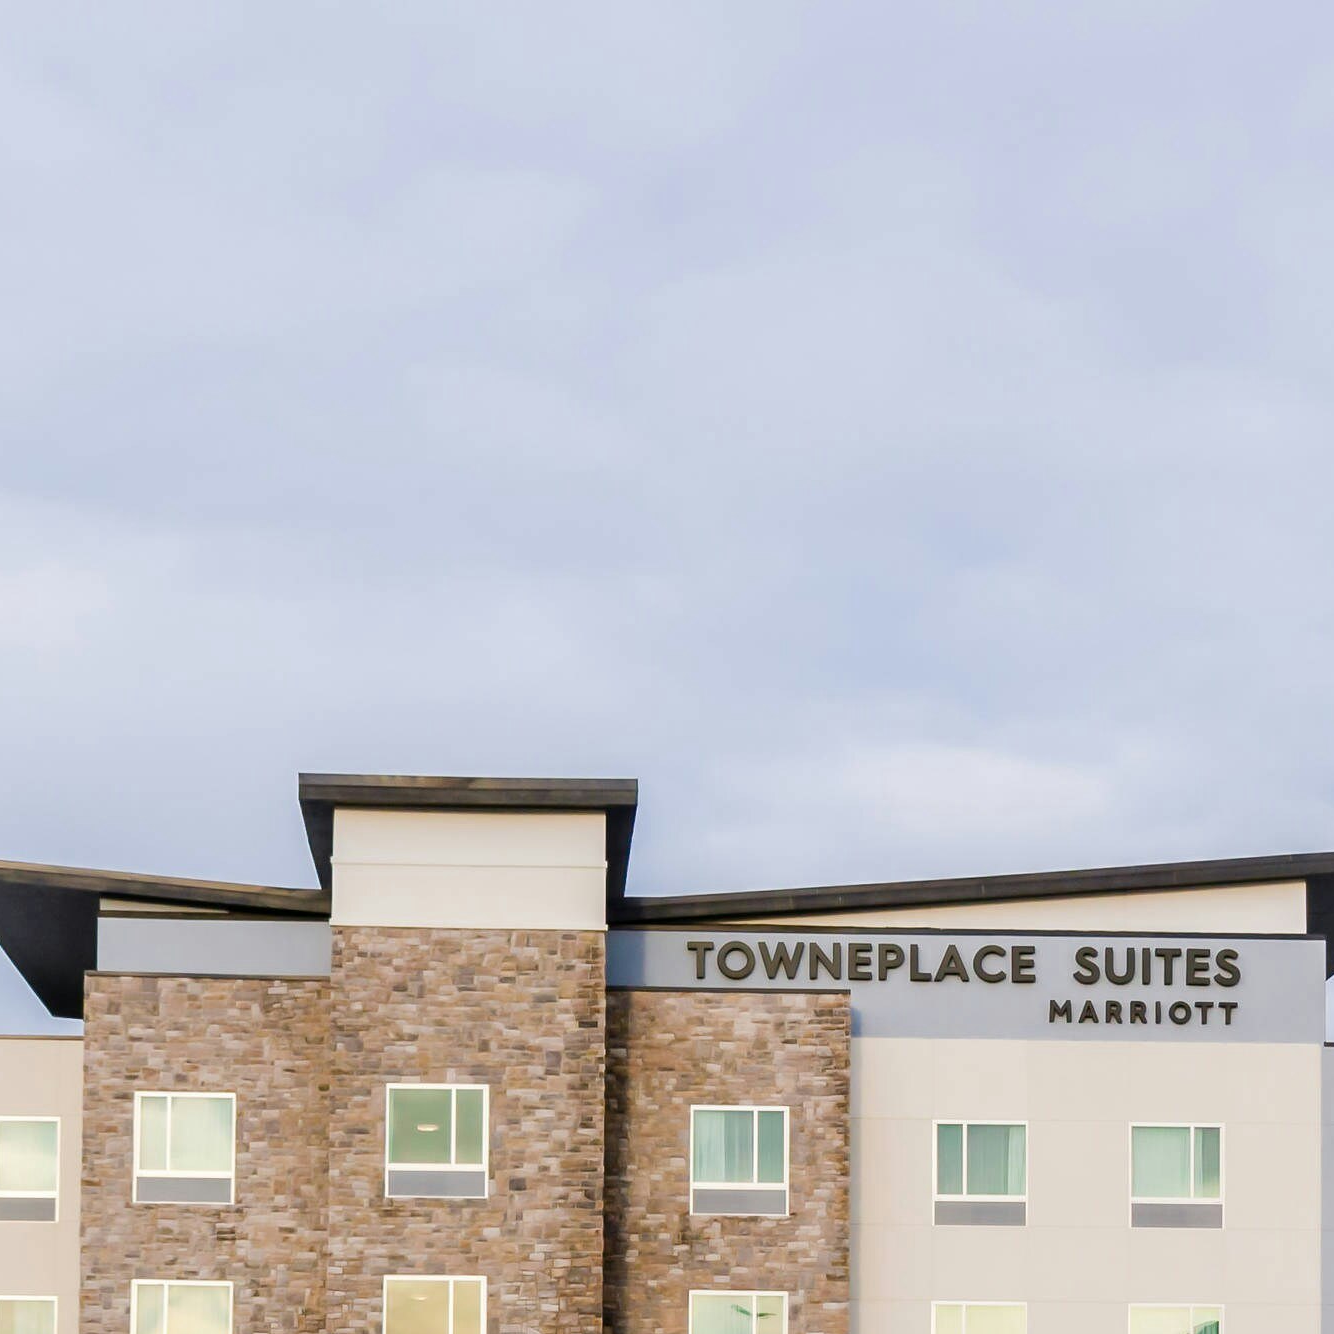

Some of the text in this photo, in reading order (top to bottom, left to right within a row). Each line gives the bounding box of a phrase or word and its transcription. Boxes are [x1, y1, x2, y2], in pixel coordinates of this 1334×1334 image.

[687, 941, 1242, 987] TOWNEPLACE SUITES
[1049, 1000, 1238, 1025] MARRIOTT
